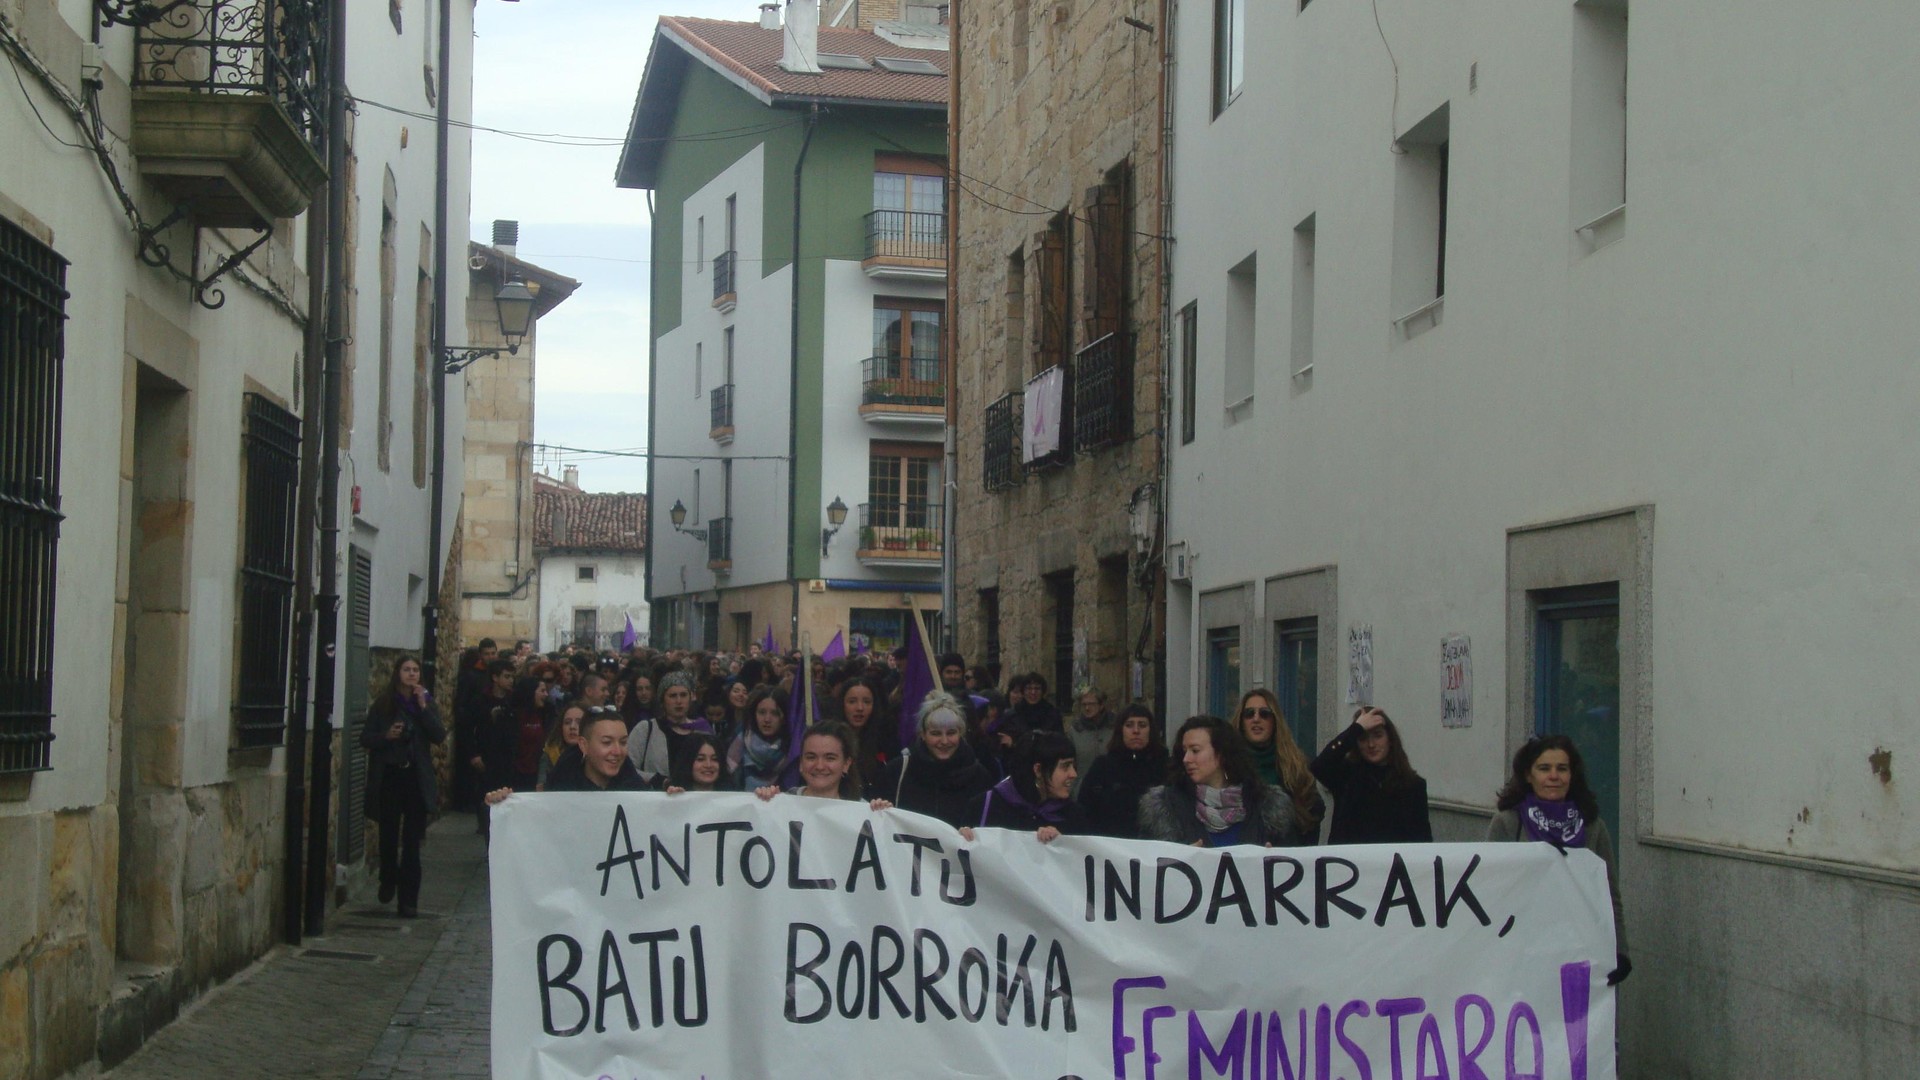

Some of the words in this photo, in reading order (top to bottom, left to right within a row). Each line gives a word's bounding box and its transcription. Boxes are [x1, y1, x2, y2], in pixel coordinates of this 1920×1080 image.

[596, 803, 978, 907] ANTOLATU
[1084, 852, 1516, 938] INDARRAK,
[536, 924, 708, 1037] BATU
[783, 922, 1077, 1033] BORROKA
[1112, 961, 1592, 1080] FEMINISTARA!
